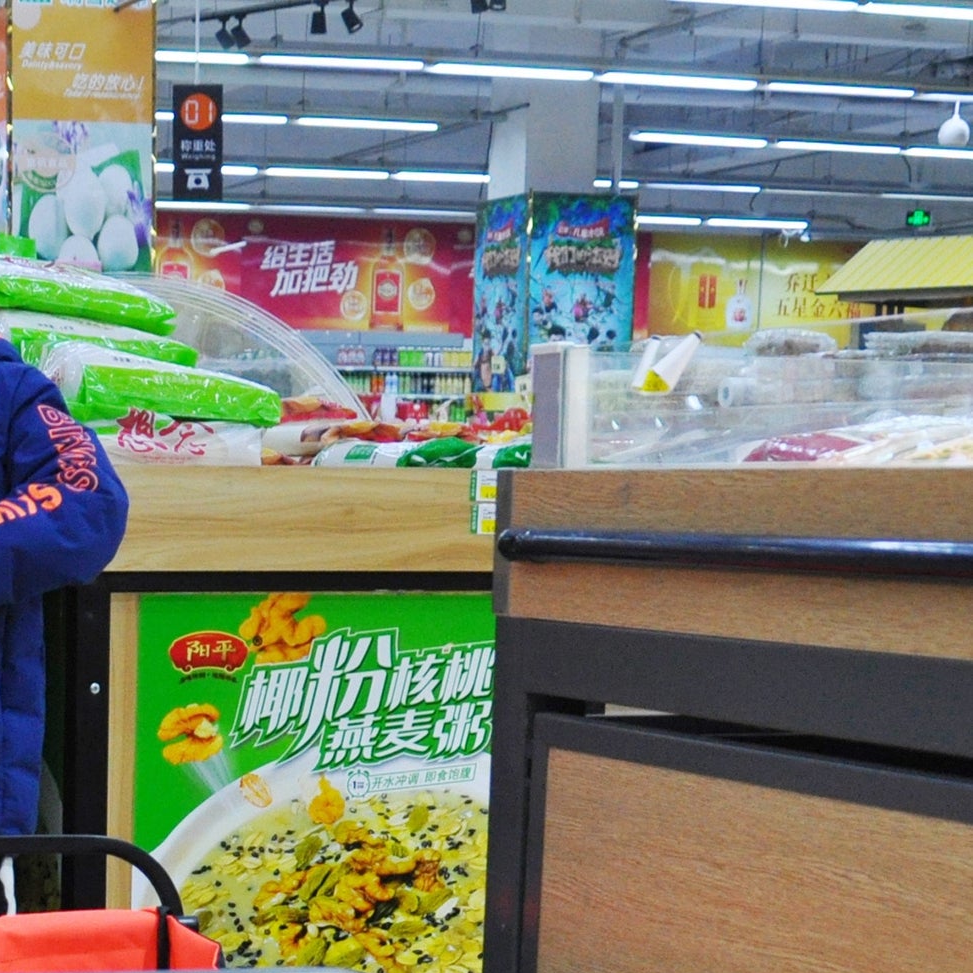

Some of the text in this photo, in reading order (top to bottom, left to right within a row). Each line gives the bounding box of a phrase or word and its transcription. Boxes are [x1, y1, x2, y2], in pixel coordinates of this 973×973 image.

[184, 100, 214, 129] 01
[180, 138, 217, 153] 称重处
[261, 241, 336, 270] 给生活
[270, 261, 359, 297] 加把劲
[117, 406, 214, 456] 想念
[186, 640, 237, 661] 阳平
[326, 701, 492, 760] 燕麦粥
